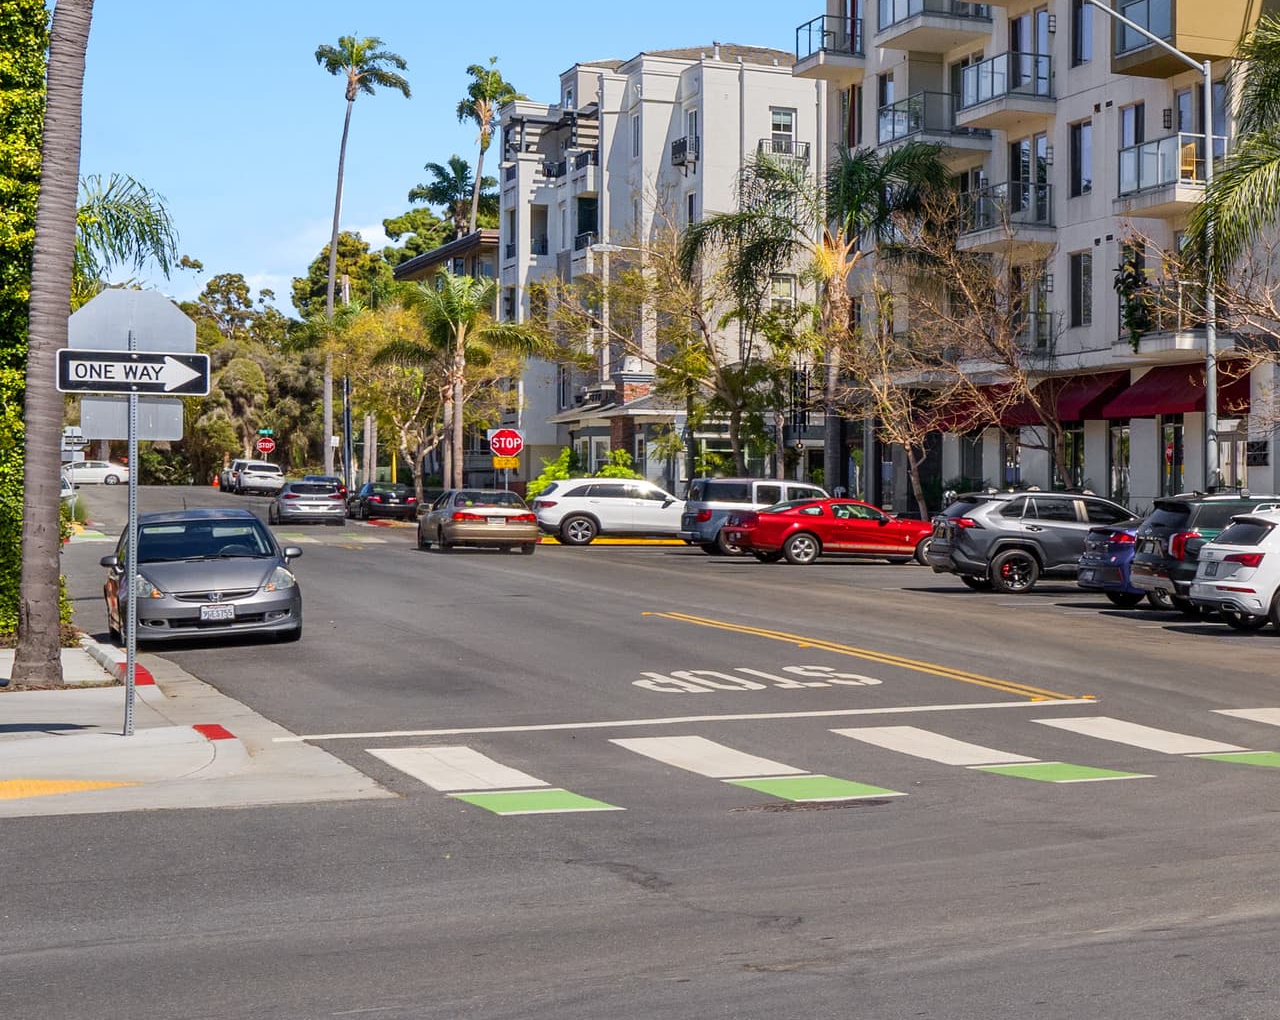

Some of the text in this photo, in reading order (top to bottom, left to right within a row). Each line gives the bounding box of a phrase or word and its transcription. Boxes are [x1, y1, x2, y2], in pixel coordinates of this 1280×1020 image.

[75, 363, 164, 381] ONE WAY
[492, 437, 522, 448] STOP
[632, 665, 883, 693] STOP
